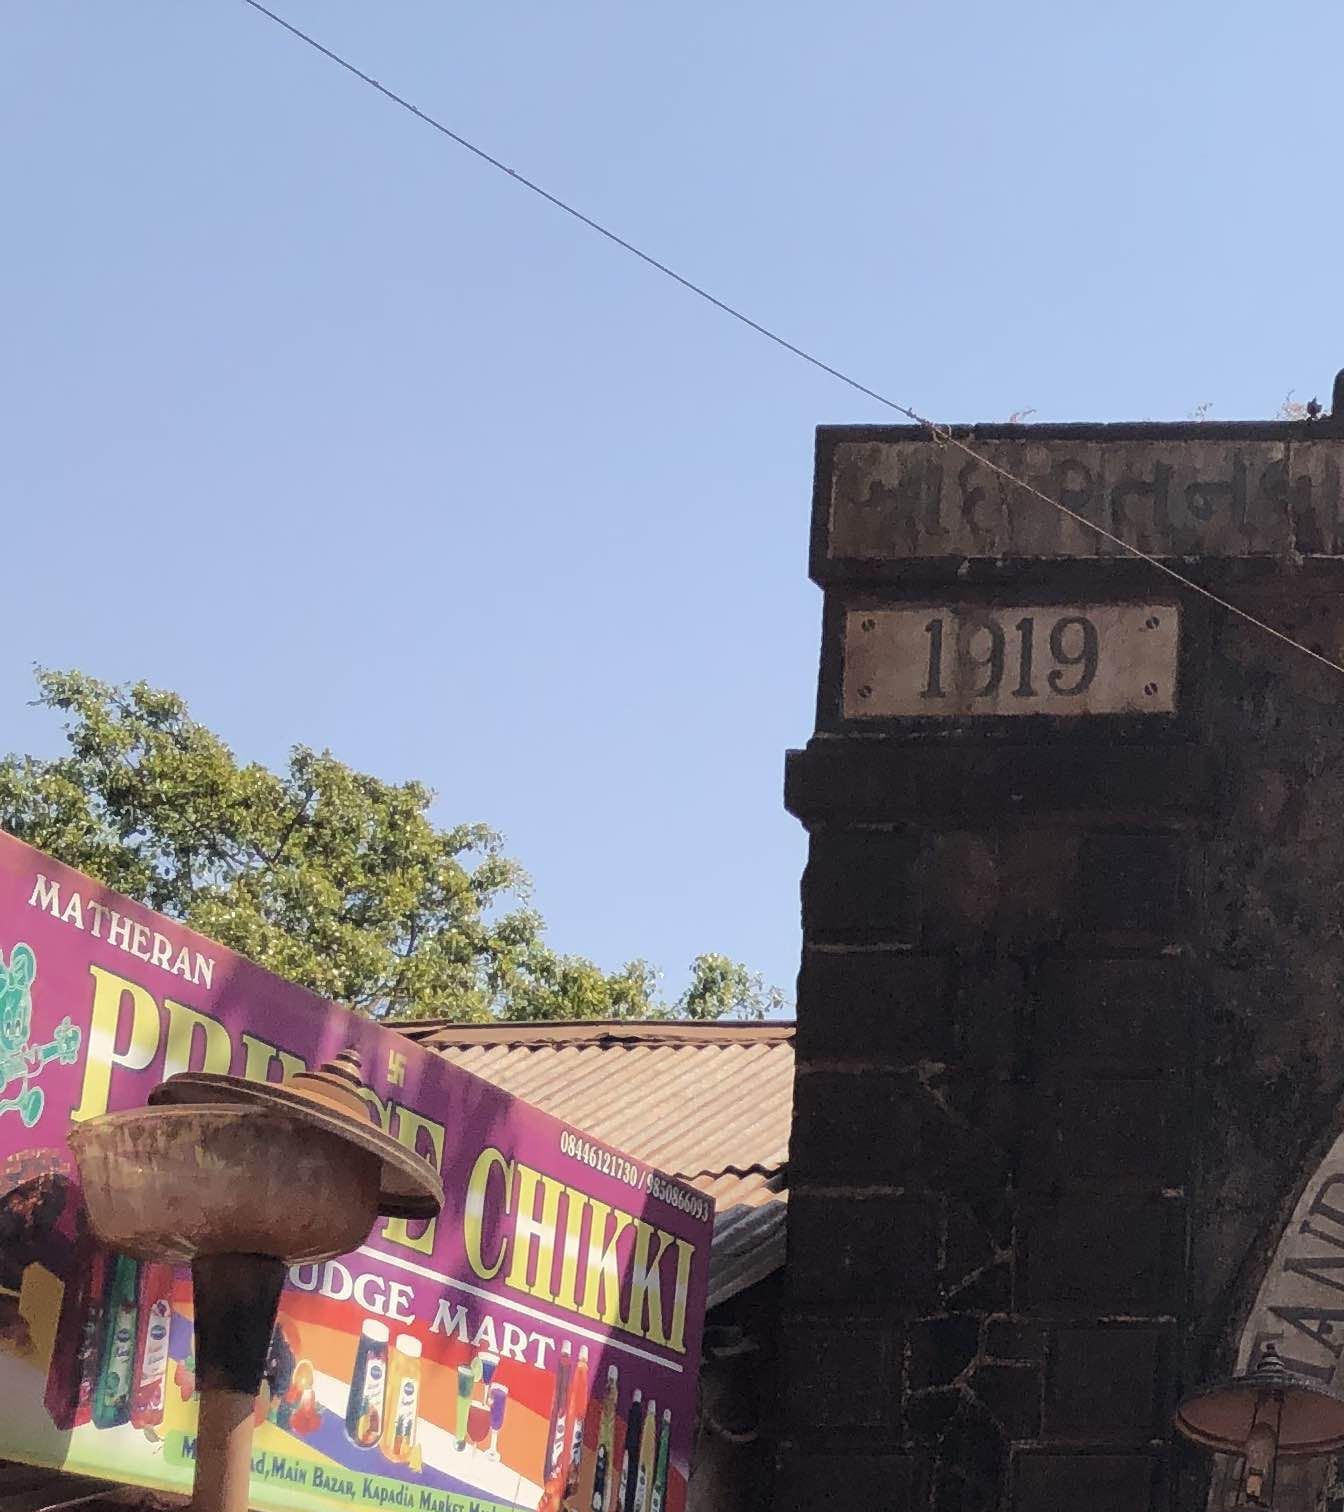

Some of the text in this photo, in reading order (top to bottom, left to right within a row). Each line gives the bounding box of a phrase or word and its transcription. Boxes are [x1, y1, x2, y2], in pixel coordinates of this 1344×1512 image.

[921, 615, 1099, 699] 1919
[28, 873, 217, 990] MATHERAN
[560, 1130, 639, 1187] 08446121730
[646, 1174, 710, 1222] 9850866093
[464, 1147, 697, 1354] CHIKKI
[289, 1261, 555, 1369] UDGE MART
